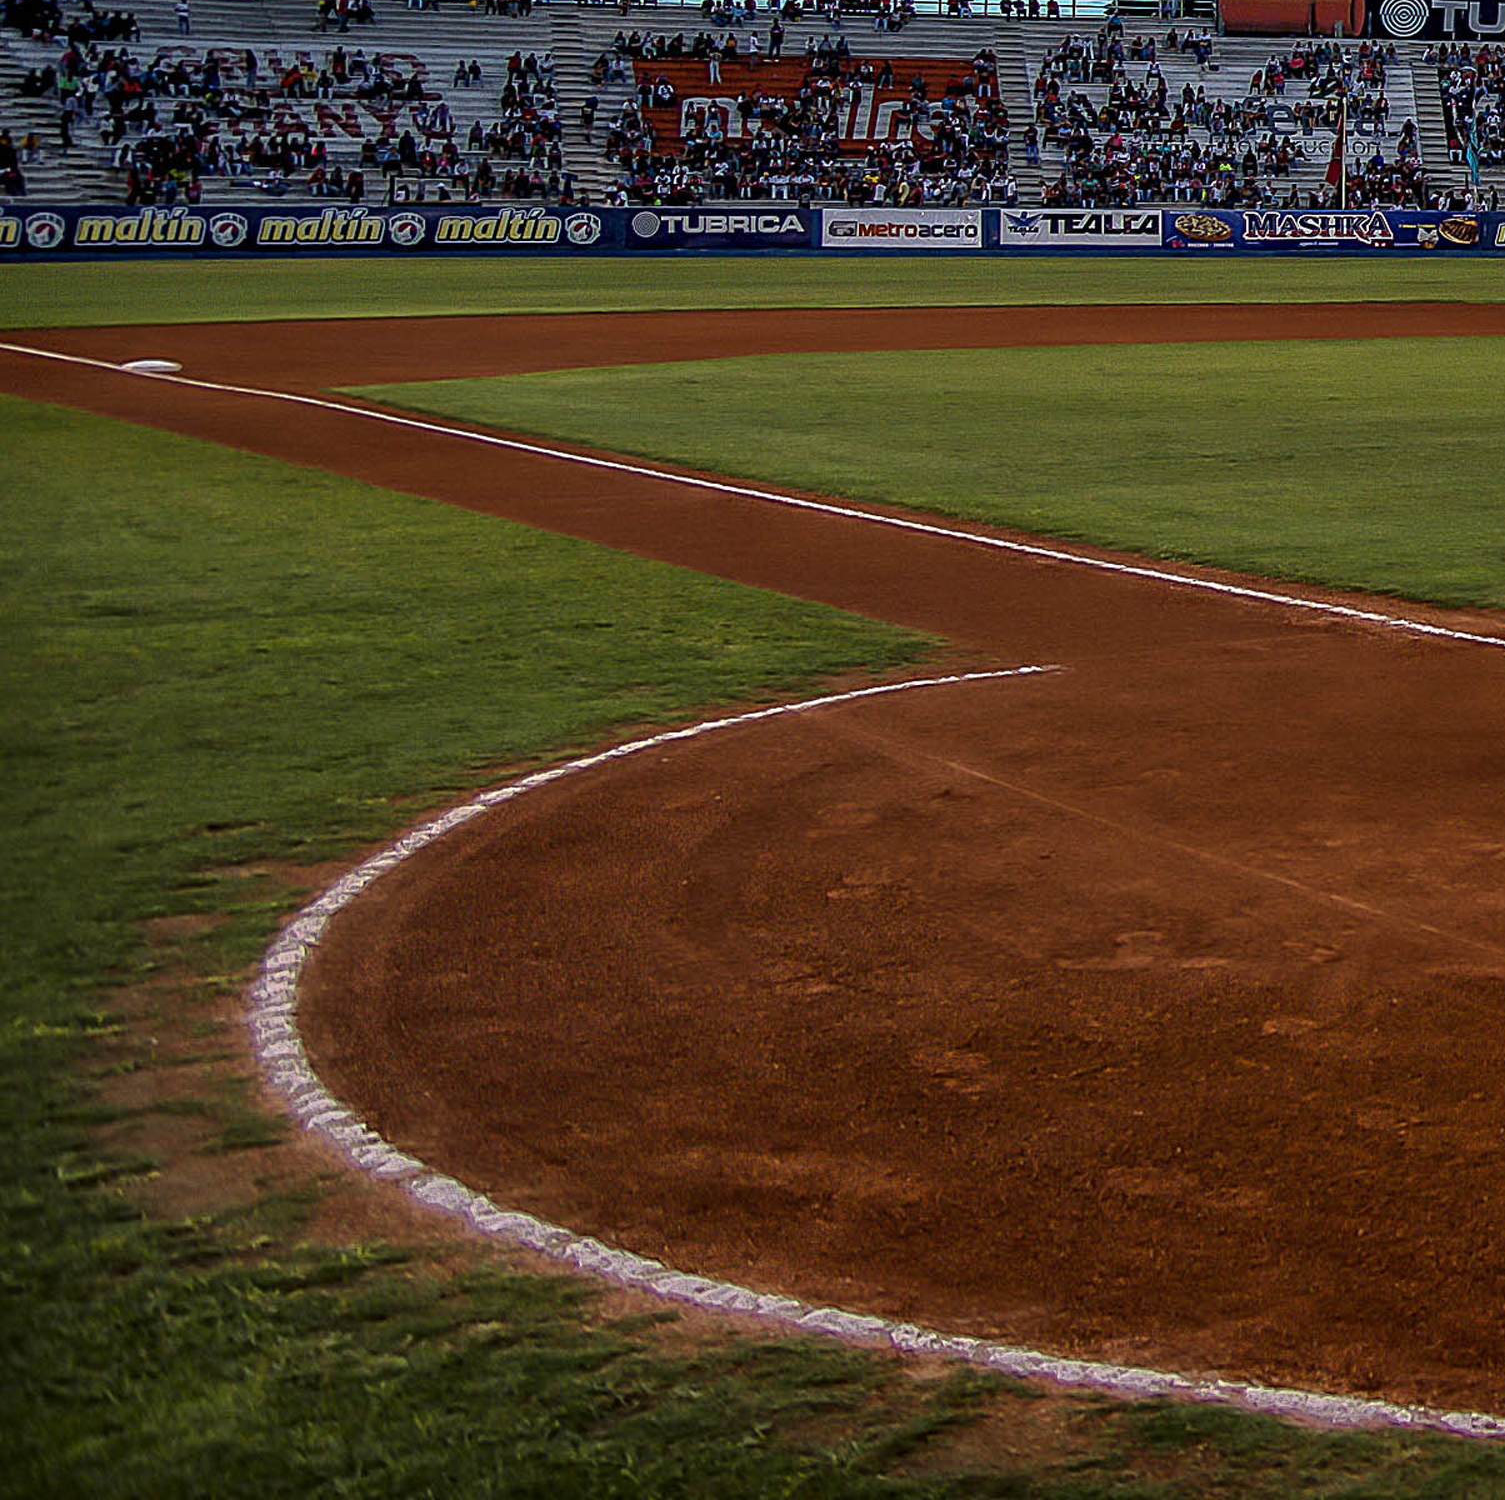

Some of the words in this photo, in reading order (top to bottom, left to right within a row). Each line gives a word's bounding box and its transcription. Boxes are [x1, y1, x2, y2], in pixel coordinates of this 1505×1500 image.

[76, 208, 204, 244] maltín
[258, 208, 385, 243] maltín
[435, 208, 561, 243] maltín
[660, 214, 804, 234] TUBRICA
[858, 222, 978, 238] Metroacero
[1244, 212, 1393, 243] MASHKA
